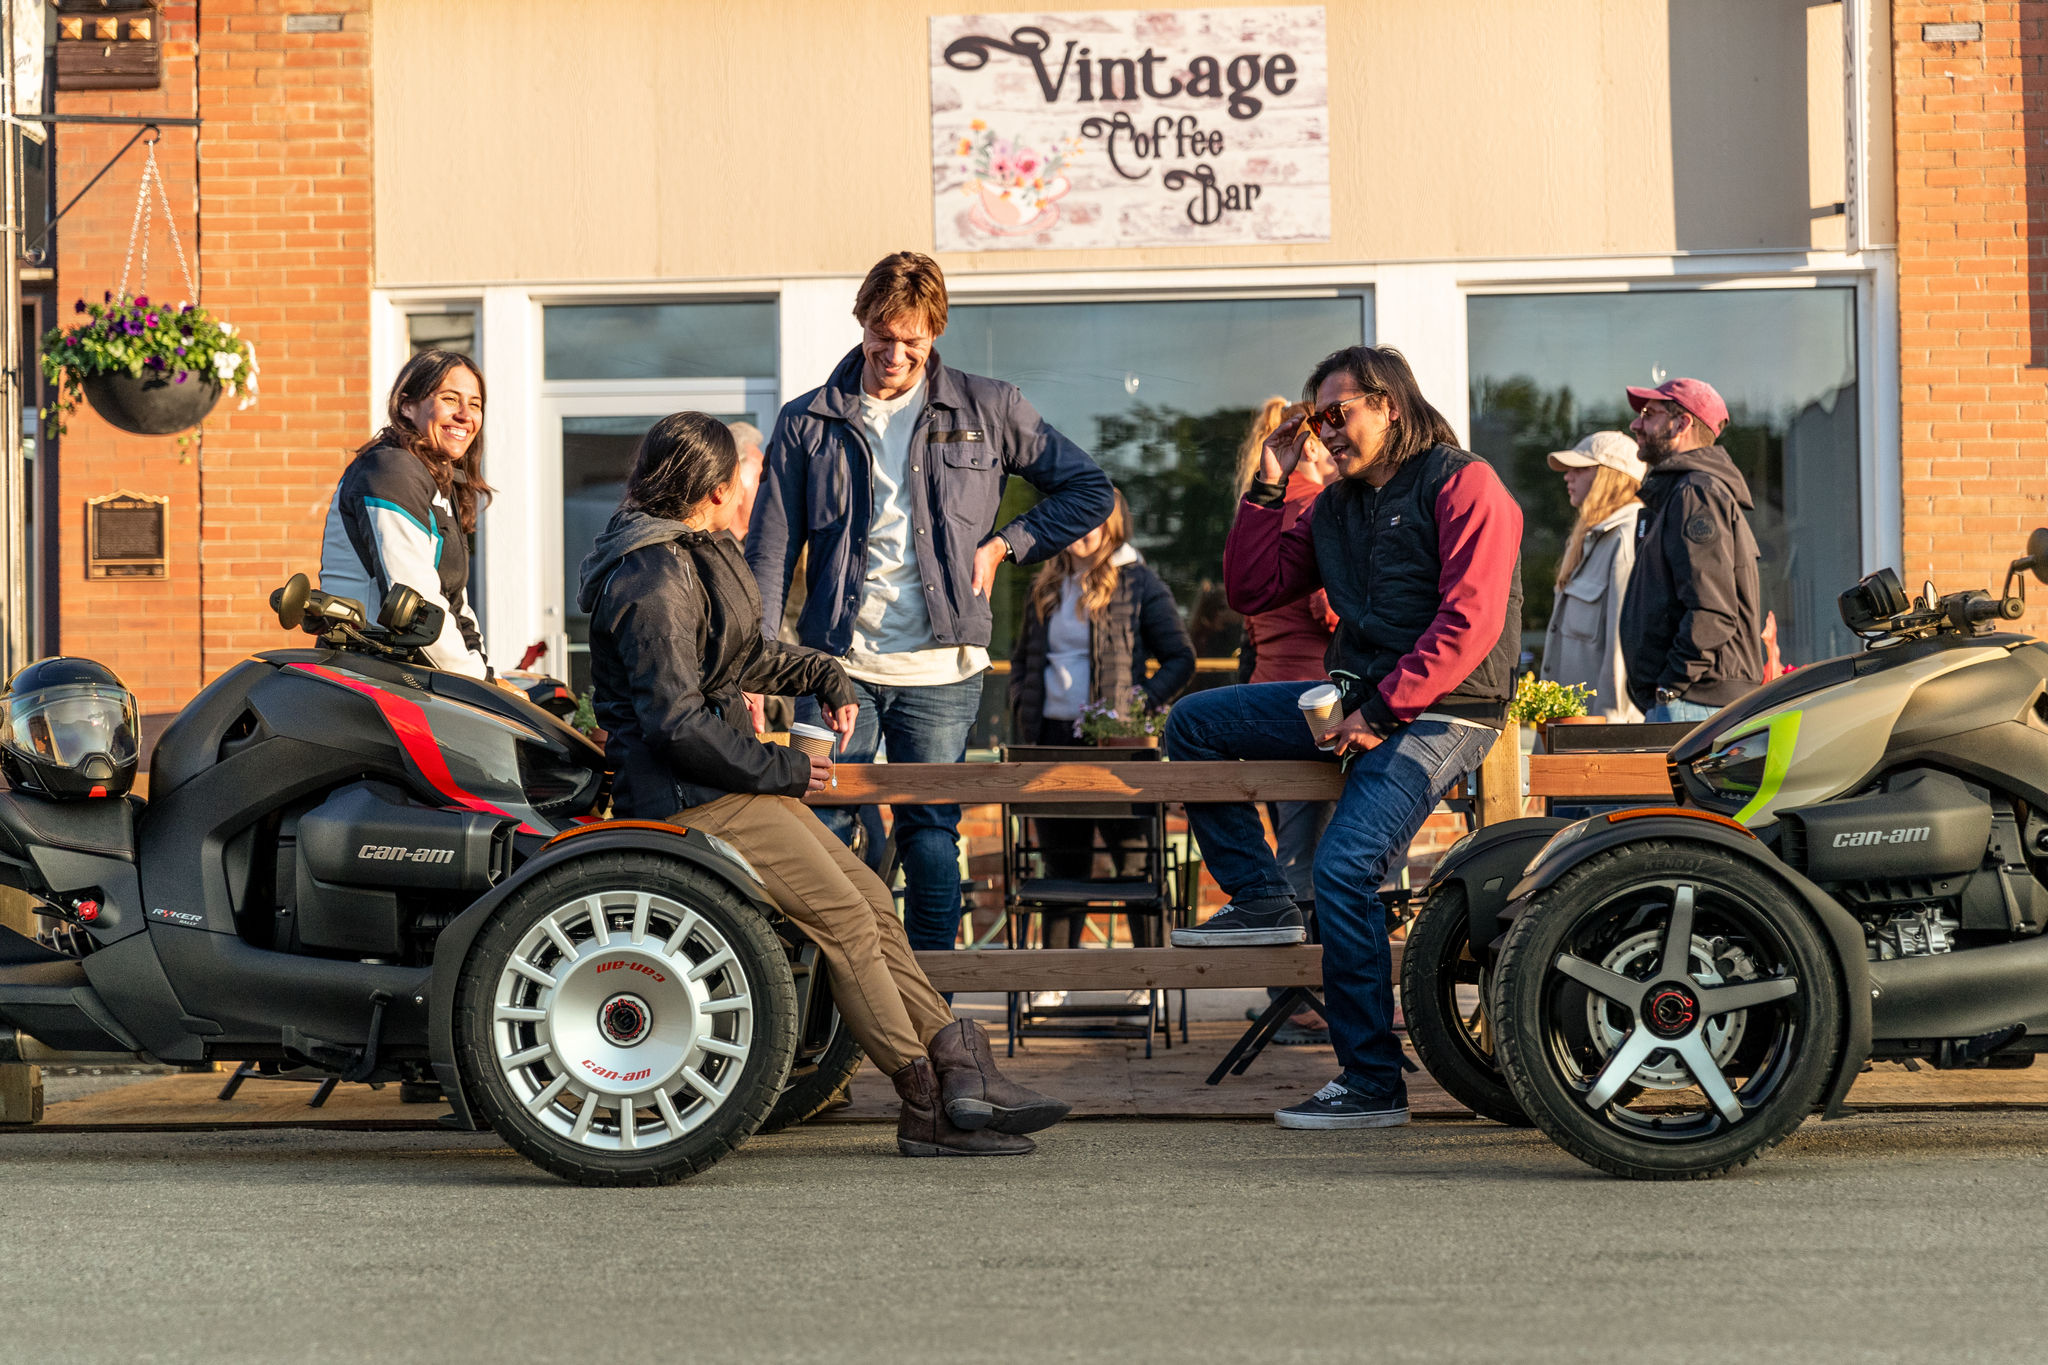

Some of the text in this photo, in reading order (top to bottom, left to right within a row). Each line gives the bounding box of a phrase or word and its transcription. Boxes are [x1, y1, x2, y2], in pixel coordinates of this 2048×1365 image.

[944, 26, 1298, 120] Vintage
[1080, 111, 1225, 180] Coffee
[1163, 164, 1262, 226] Bar
[1832, 826, 1930, 848] can-am
[357, 844, 455, 864] can-am
[152, 908, 203, 922] RYKER
[596, 960, 666, 983] can-am
[581, 1059, 651, 1082] can-am
